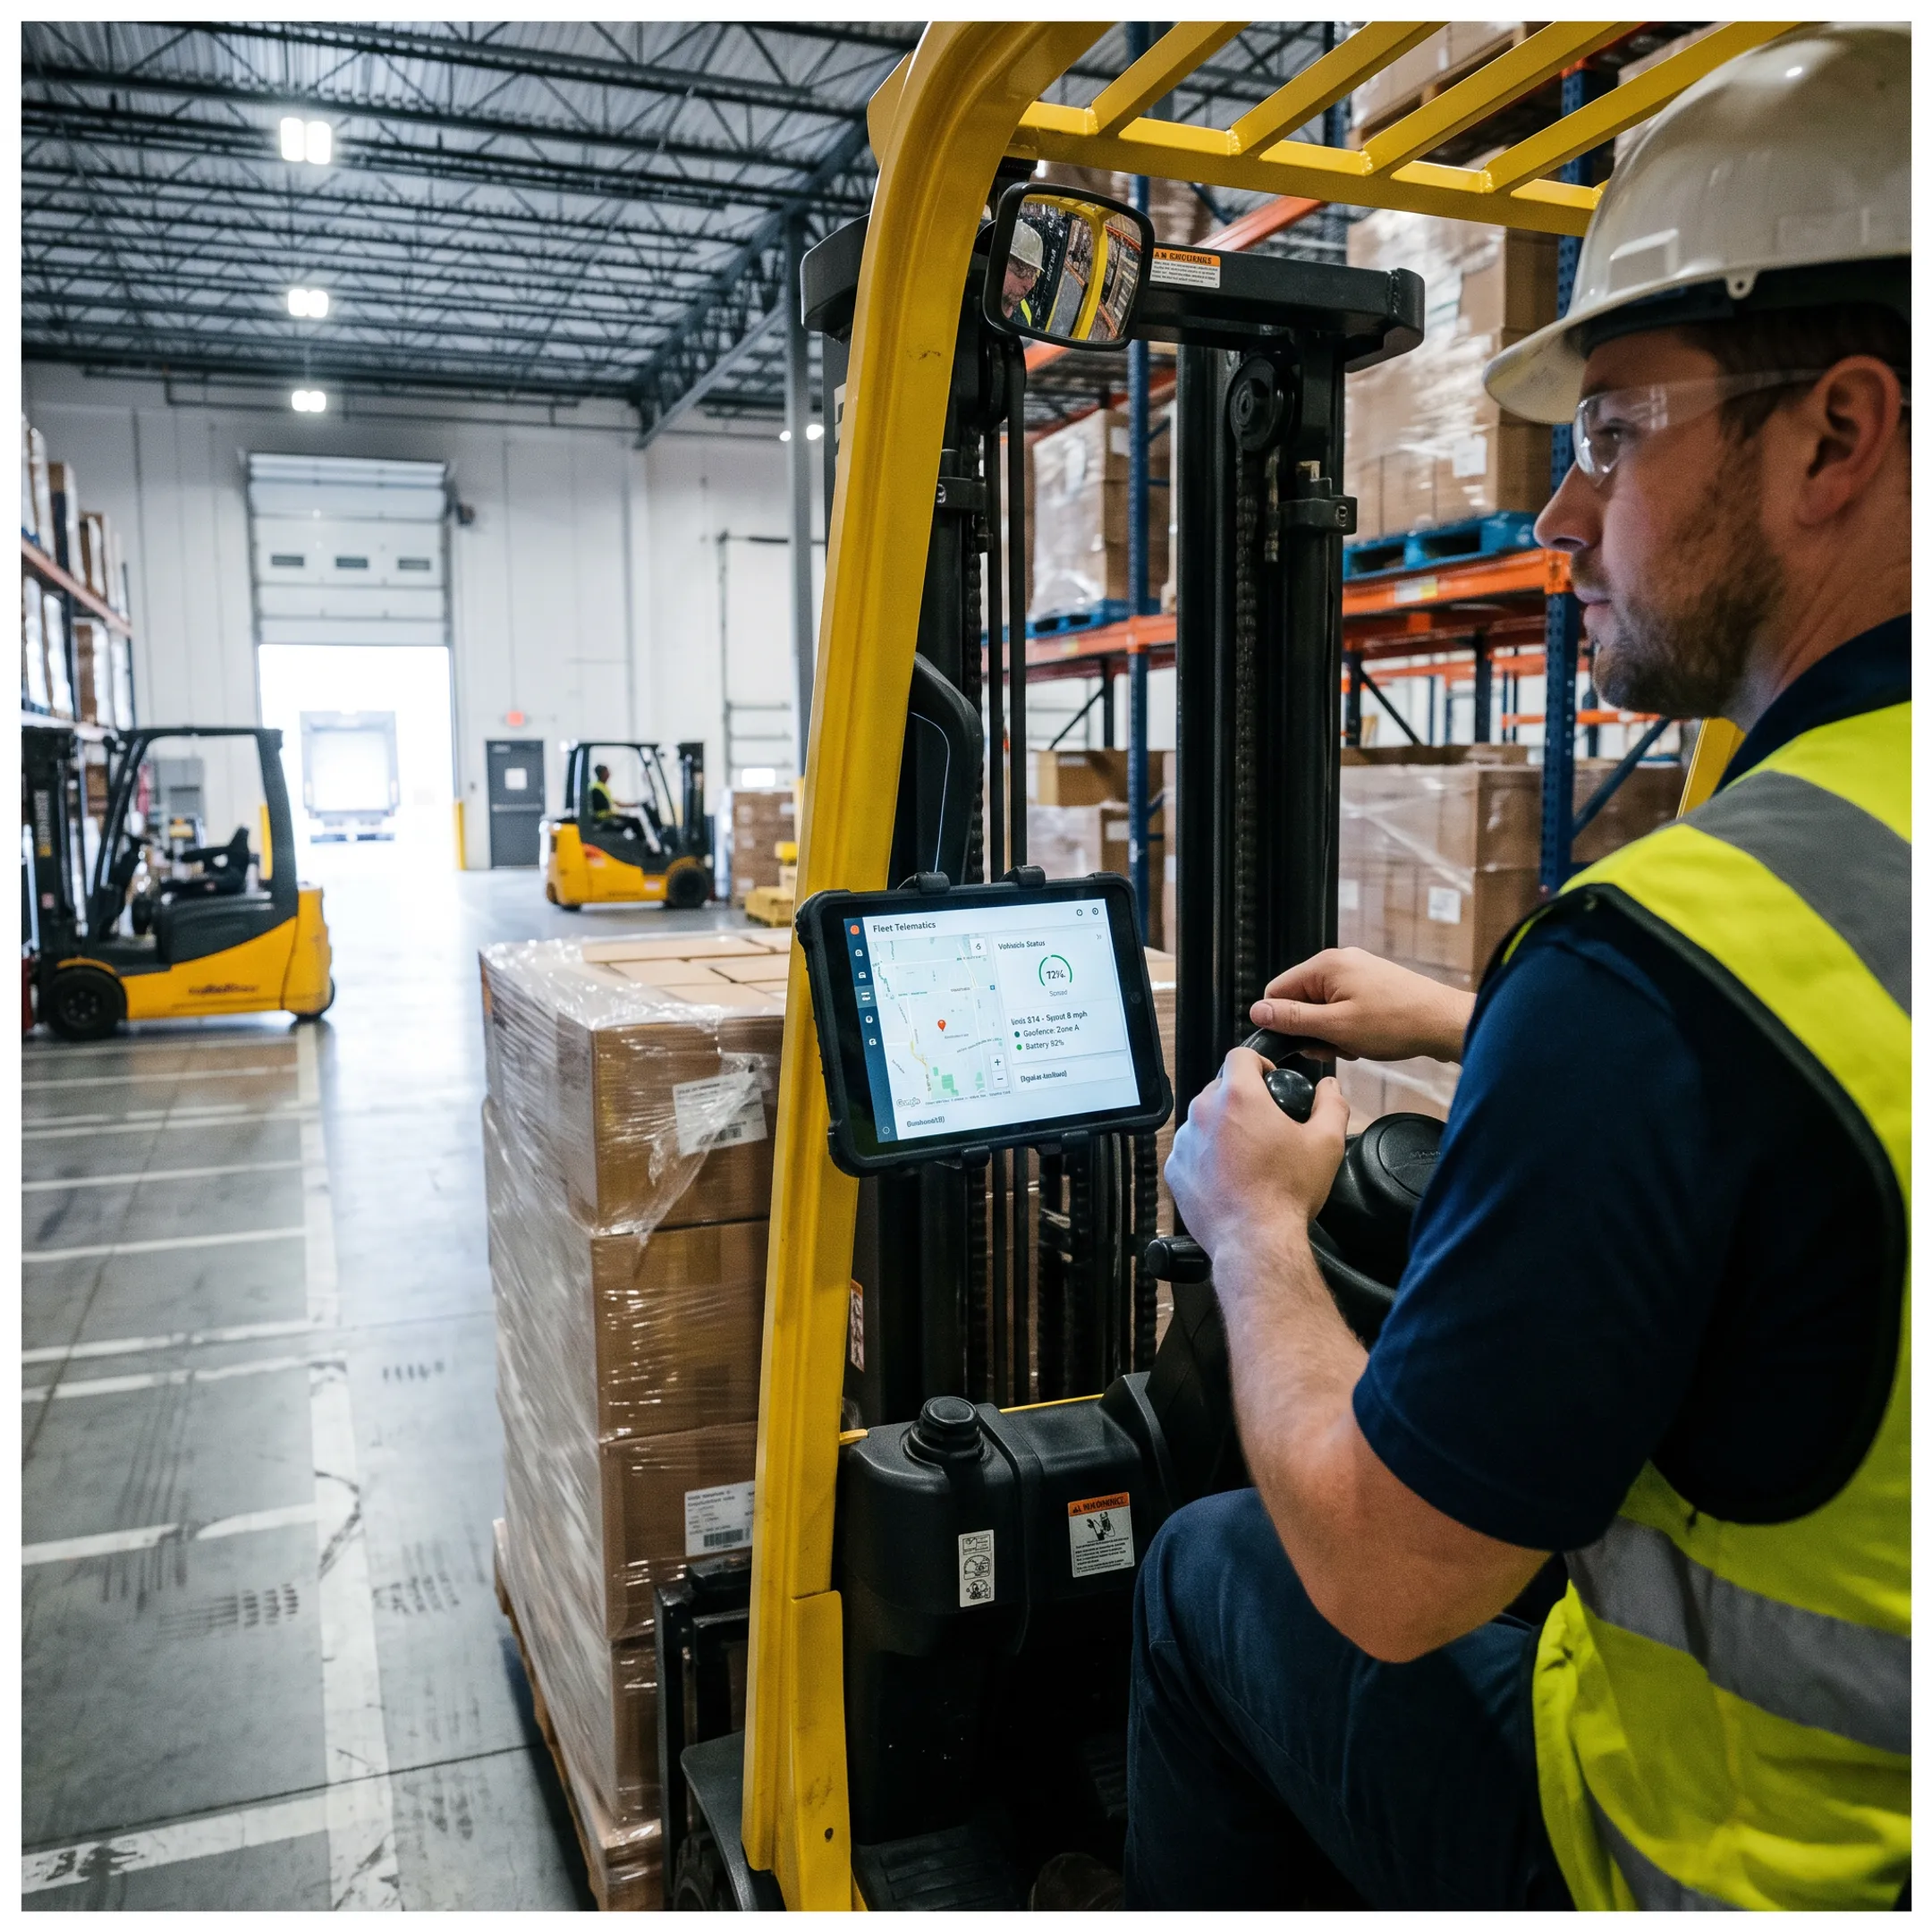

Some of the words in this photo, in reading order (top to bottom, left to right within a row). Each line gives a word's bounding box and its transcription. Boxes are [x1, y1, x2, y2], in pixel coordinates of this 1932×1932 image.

[873, 925, 894, 933] Fleet
[894, 921, 936, 931] Telematics
[1072, 1011, 1088, 1020] mph
[1025, 1041, 1049, 1050] Battery
